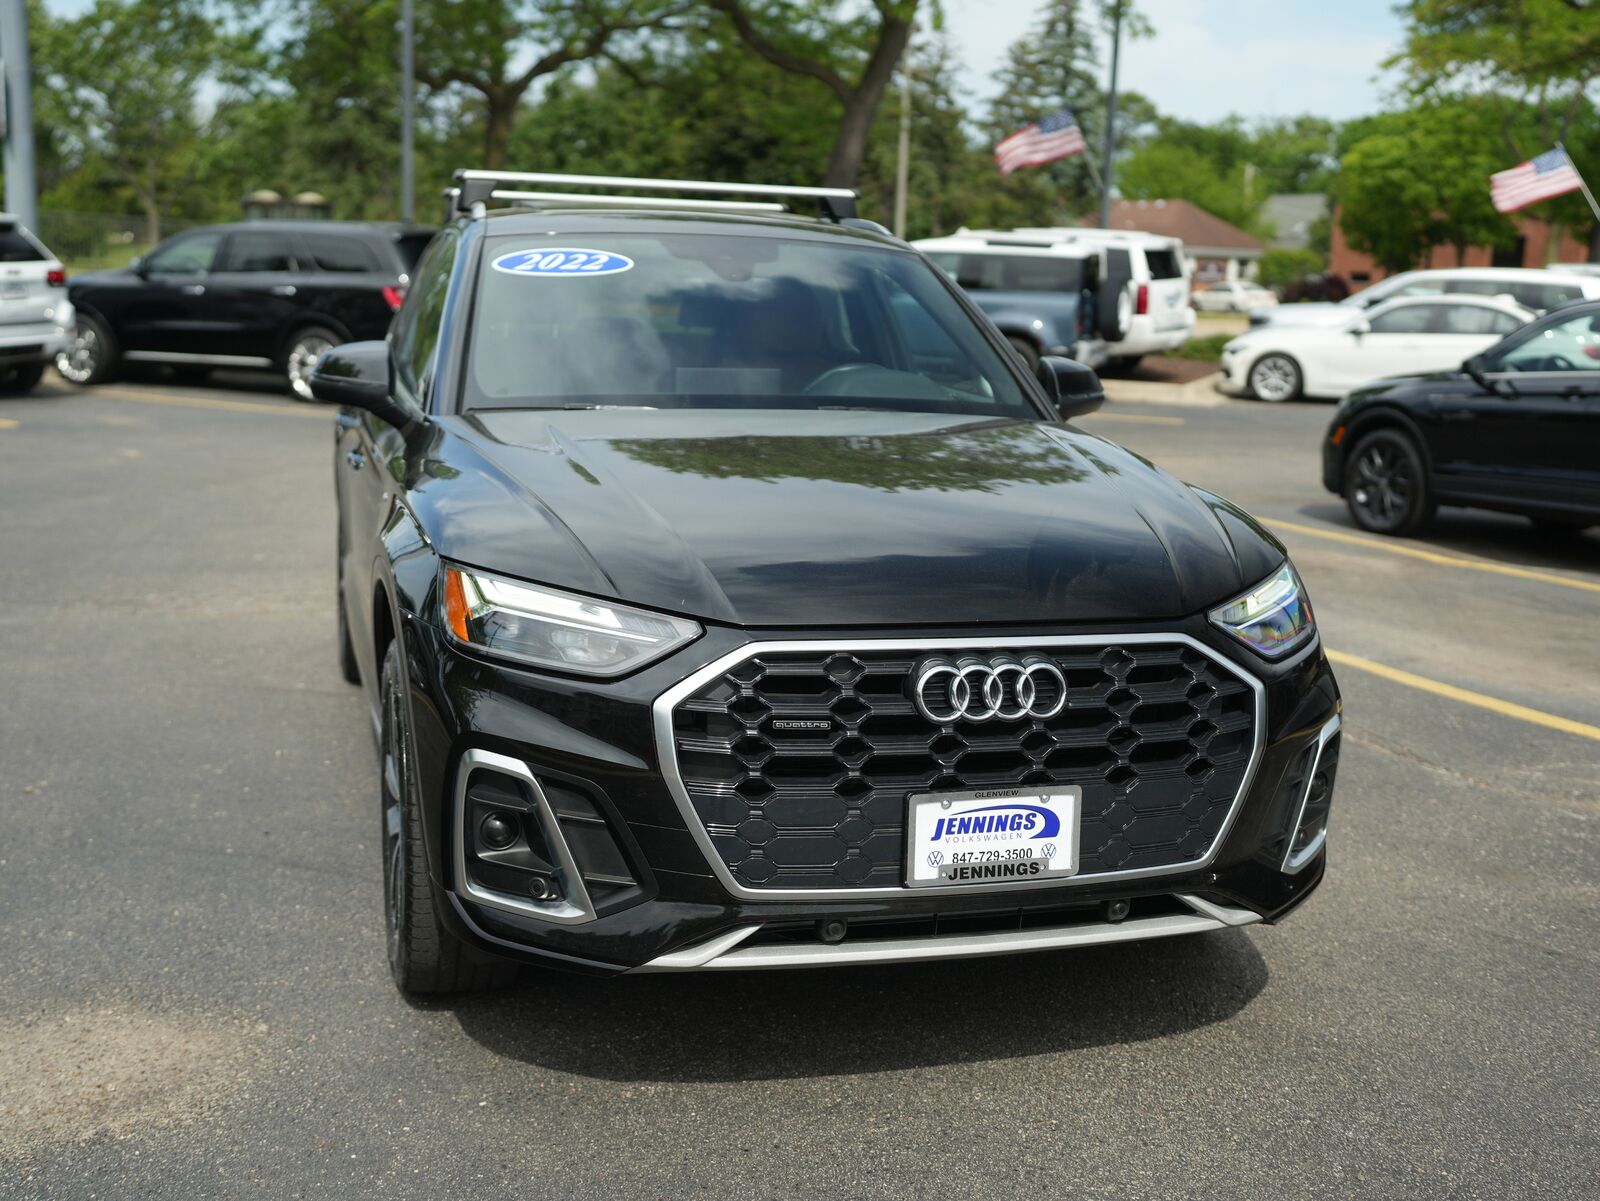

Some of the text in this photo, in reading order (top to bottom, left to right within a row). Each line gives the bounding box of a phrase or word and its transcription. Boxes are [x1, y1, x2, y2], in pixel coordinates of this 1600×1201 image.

[512, 252, 610, 271] 2022
[974, 789, 1020, 799] GLENVIEW
[930, 812, 1038, 842] JENNINGS
[944, 832, 1024, 844] VOLKSWAGEN
[951, 847, 1033, 865] 847-729-3500
[947, 861, 1040, 881] JENNINGS
